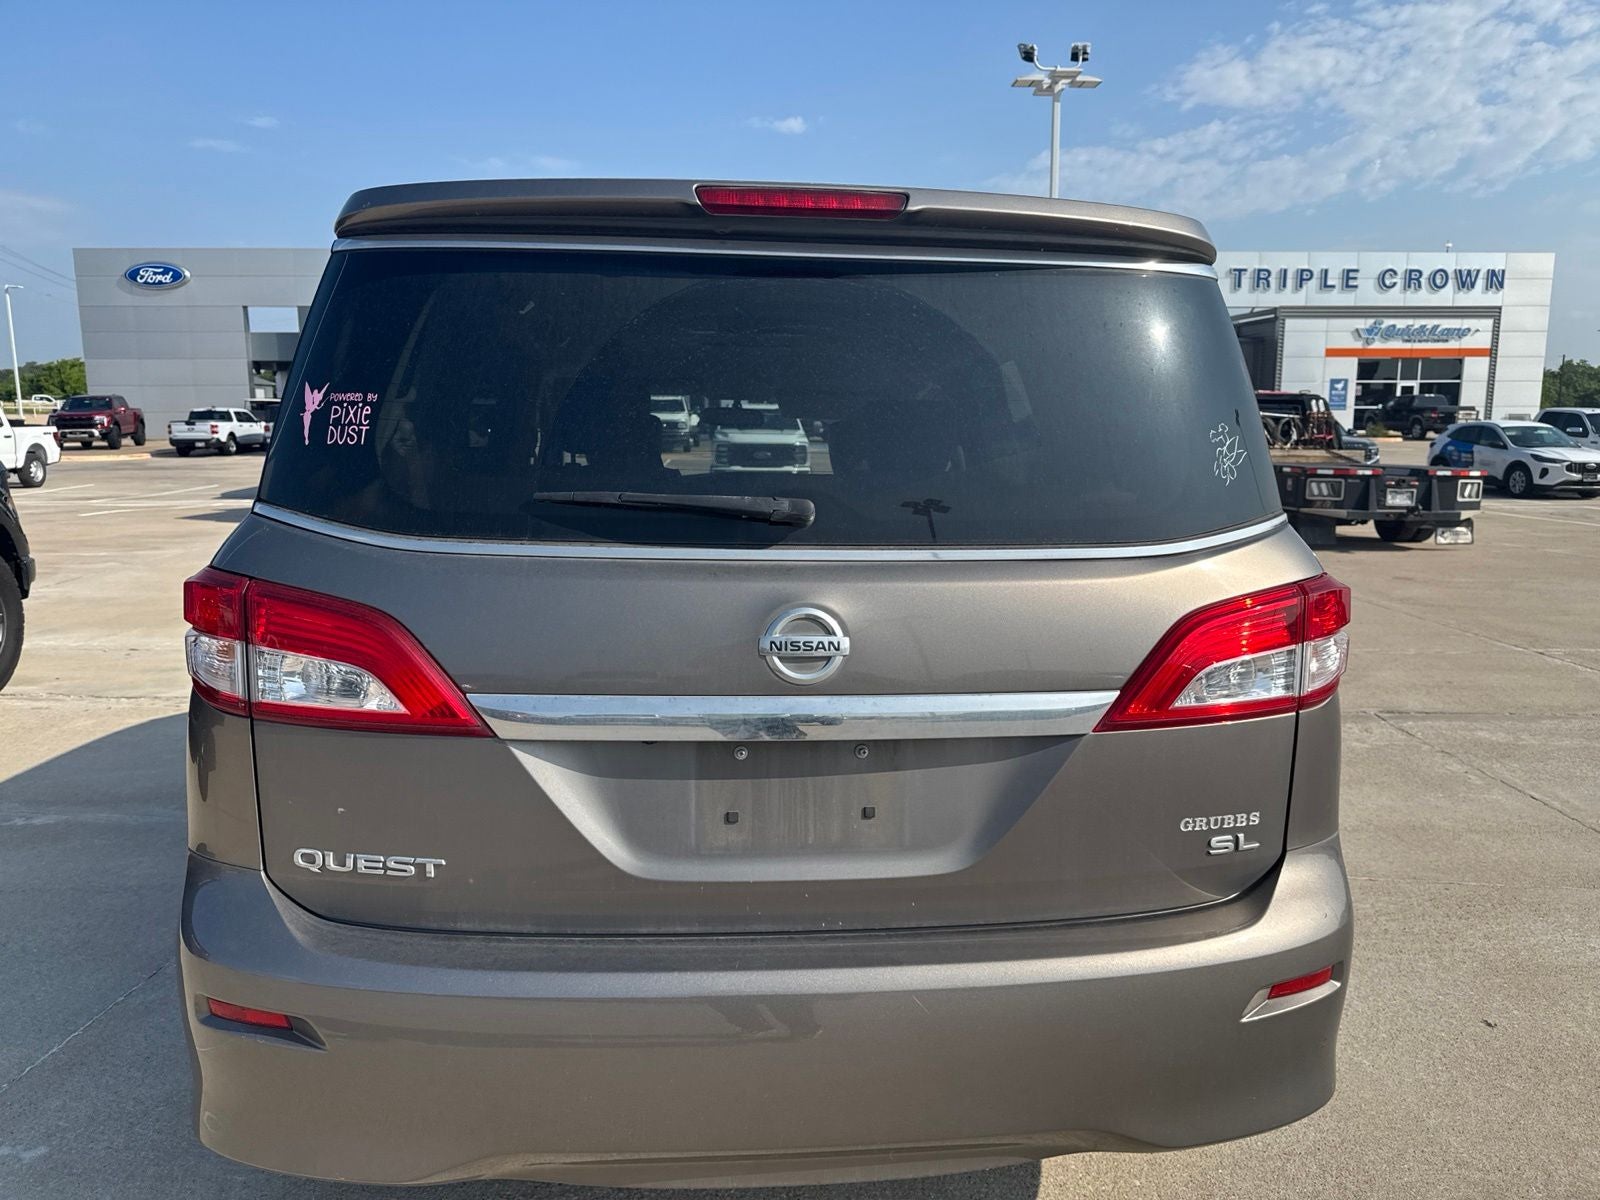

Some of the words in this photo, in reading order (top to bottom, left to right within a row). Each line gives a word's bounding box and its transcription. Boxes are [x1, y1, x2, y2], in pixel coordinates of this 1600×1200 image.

[136, 267, 173, 283] Ford
[1229, 268, 1361, 292] TRIPLE
[1377, 268, 1506, 292] CROWN
[366, 392, 378, 402] BY
[327, 425, 370, 445] DUST
[769, 640, 841, 652] NISSAN
[1180, 811, 1260, 832] GRUBBS
[1207, 833, 1260, 855] SL
[293, 848, 446, 878] QUEST
